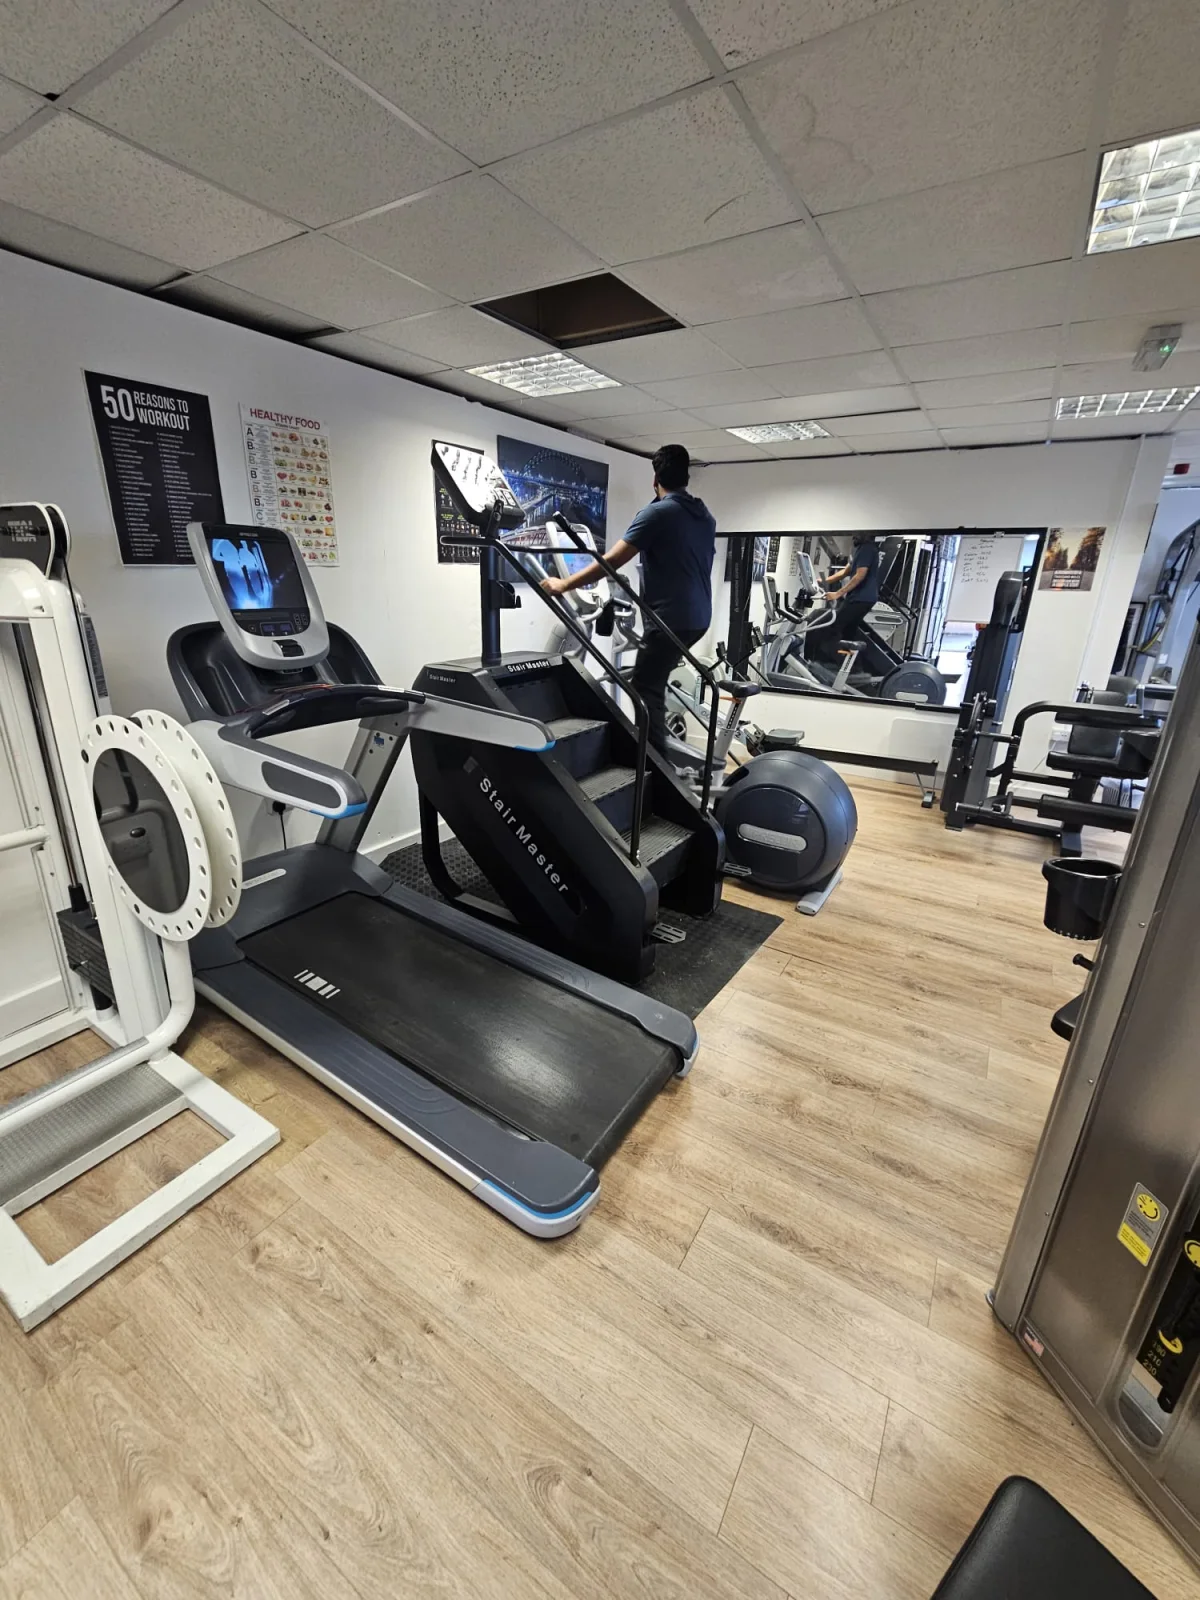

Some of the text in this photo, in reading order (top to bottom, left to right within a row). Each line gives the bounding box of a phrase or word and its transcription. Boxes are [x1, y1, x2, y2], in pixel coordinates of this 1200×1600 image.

[100, 384, 136, 422] 50
[133, 390, 189, 414] REASONS TO
[135, 407, 190, 431] WORKOUT
[249, 407, 293, 425] HEALTHY
[295, 417, 321, 431] FOOD
